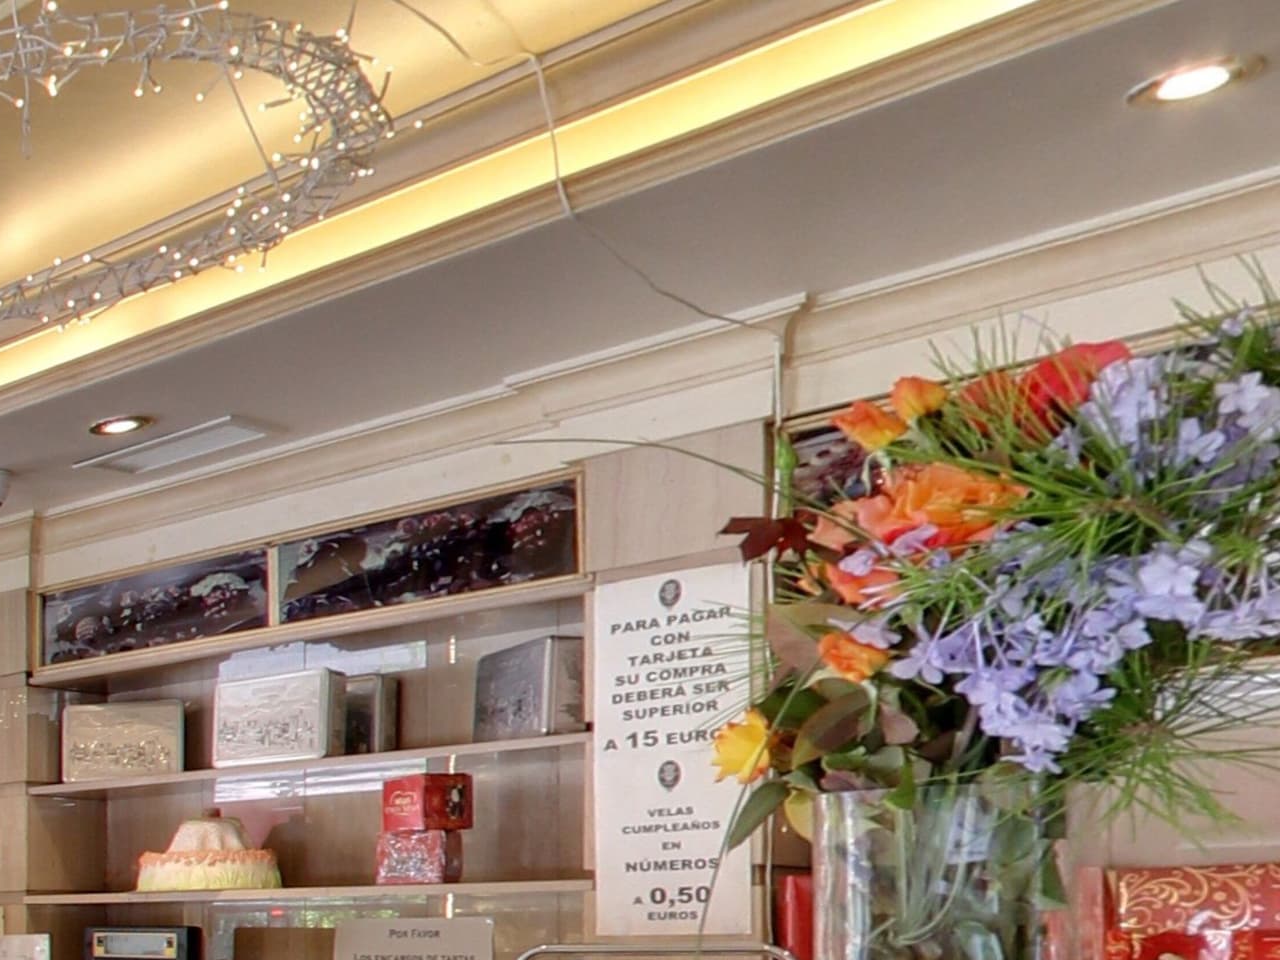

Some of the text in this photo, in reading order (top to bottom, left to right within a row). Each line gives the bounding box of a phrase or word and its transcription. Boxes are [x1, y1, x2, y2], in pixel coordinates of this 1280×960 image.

[610, 606, 731, 635] PARA PAGAR
[650, 631, 690, 646] CON
[628, 646, 713, 668] TARJETA
[615, 663, 727, 687] SU COMPRA
[692, 680, 730, 695] SER
[622, 699, 719, 721] SUPERIOR
[604, 739, 618, 751] A
[625, 730, 659, 749] 15
[647, 806, 694, 817] VELAS
[622, 820, 720, 835] CUMPLEAÑOS
[661, 841, 681, 851] EN
[625, 858, 720, 873] NÚMEROS
[632, 885, 711, 908] A 0,50
[647, 911, 698, 921] EUROS
